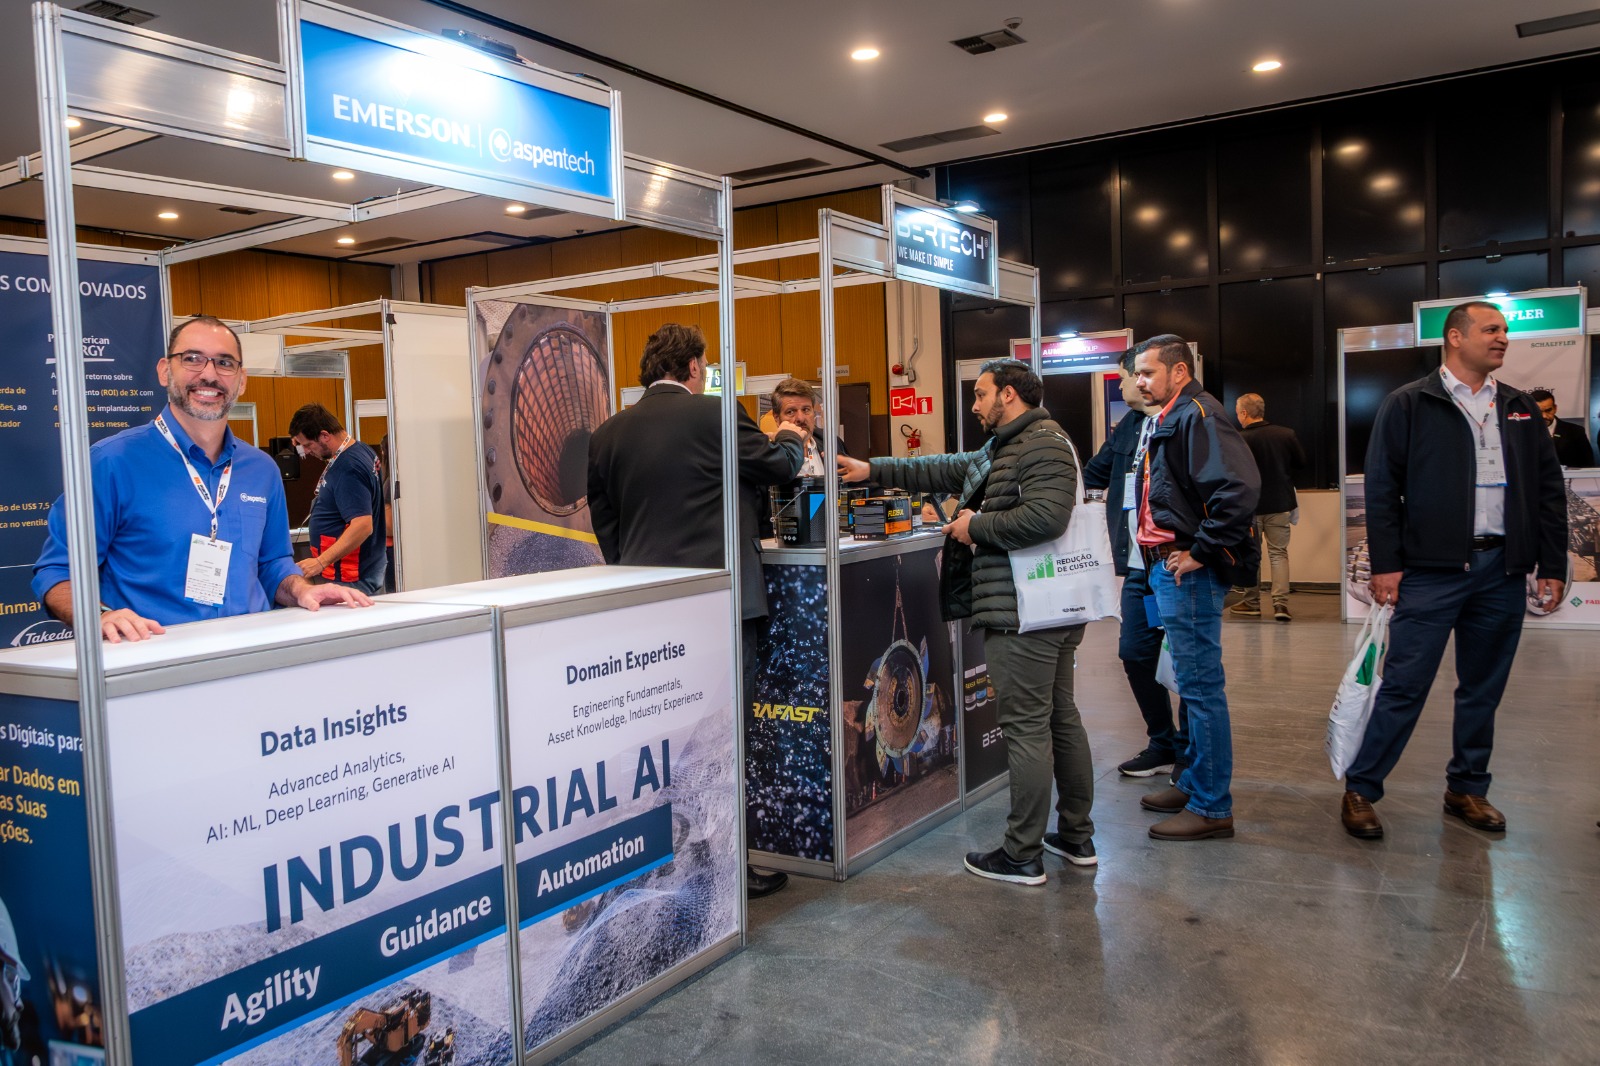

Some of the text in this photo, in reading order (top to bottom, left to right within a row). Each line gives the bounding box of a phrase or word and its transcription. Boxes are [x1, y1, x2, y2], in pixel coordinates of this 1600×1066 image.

[333, 94, 595, 176] EMERSON aspentech
[897, 245, 954, 271] WE MAKE IT SIMPLE
[1530, 340, 1576, 348] SCHAEFFLER
[113, 373, 133, 381] sobre
[16, 387, 26, 395] de
[101, 388, 119, 397] (ROI)
[97, 404, 140, 413] implantados
[91, 420, 105, 428] seis
[10, 503, 21, 511] de
[22, 502, 37, 511] US$
[38, 502, 50, 510] 7,5
[22, 518, 48, 528] ventila
[1056, 553, 1092, 566] REDUÇÃO
[1069, 560, 1100, 571] CUSTOS
[0, 601, 41, 615] Inma
[25, 628, 74, 645] Takeda
[566, 641, 686, 685] Domain Expertise
[573, 678, 683, 719] Engineering Fundamentals,
[260, 703, 408, 756] Data Insights
[547, 689, 704, 745] Asset Knowledge, Industry Experience
[9, 722, 55, 748] Digitais
[982, 727, 1003, 748] BER
[13, 765, 55, 791] Dados
[58, 777, 80, 796] em
[268, 750, 406, 799] Advanced Analytics,
[16, 794, 48, 819] Suas
[206, 756, 455, 844] AI: ML, Deep Learning, Generative AI
[263, 739, 671, 934] INDUSTRIAL AI
[537, 834, 645, 897] Automation
[380, 895, 492, 957] Guidance
[221, 965, 321, 1031] Agility
